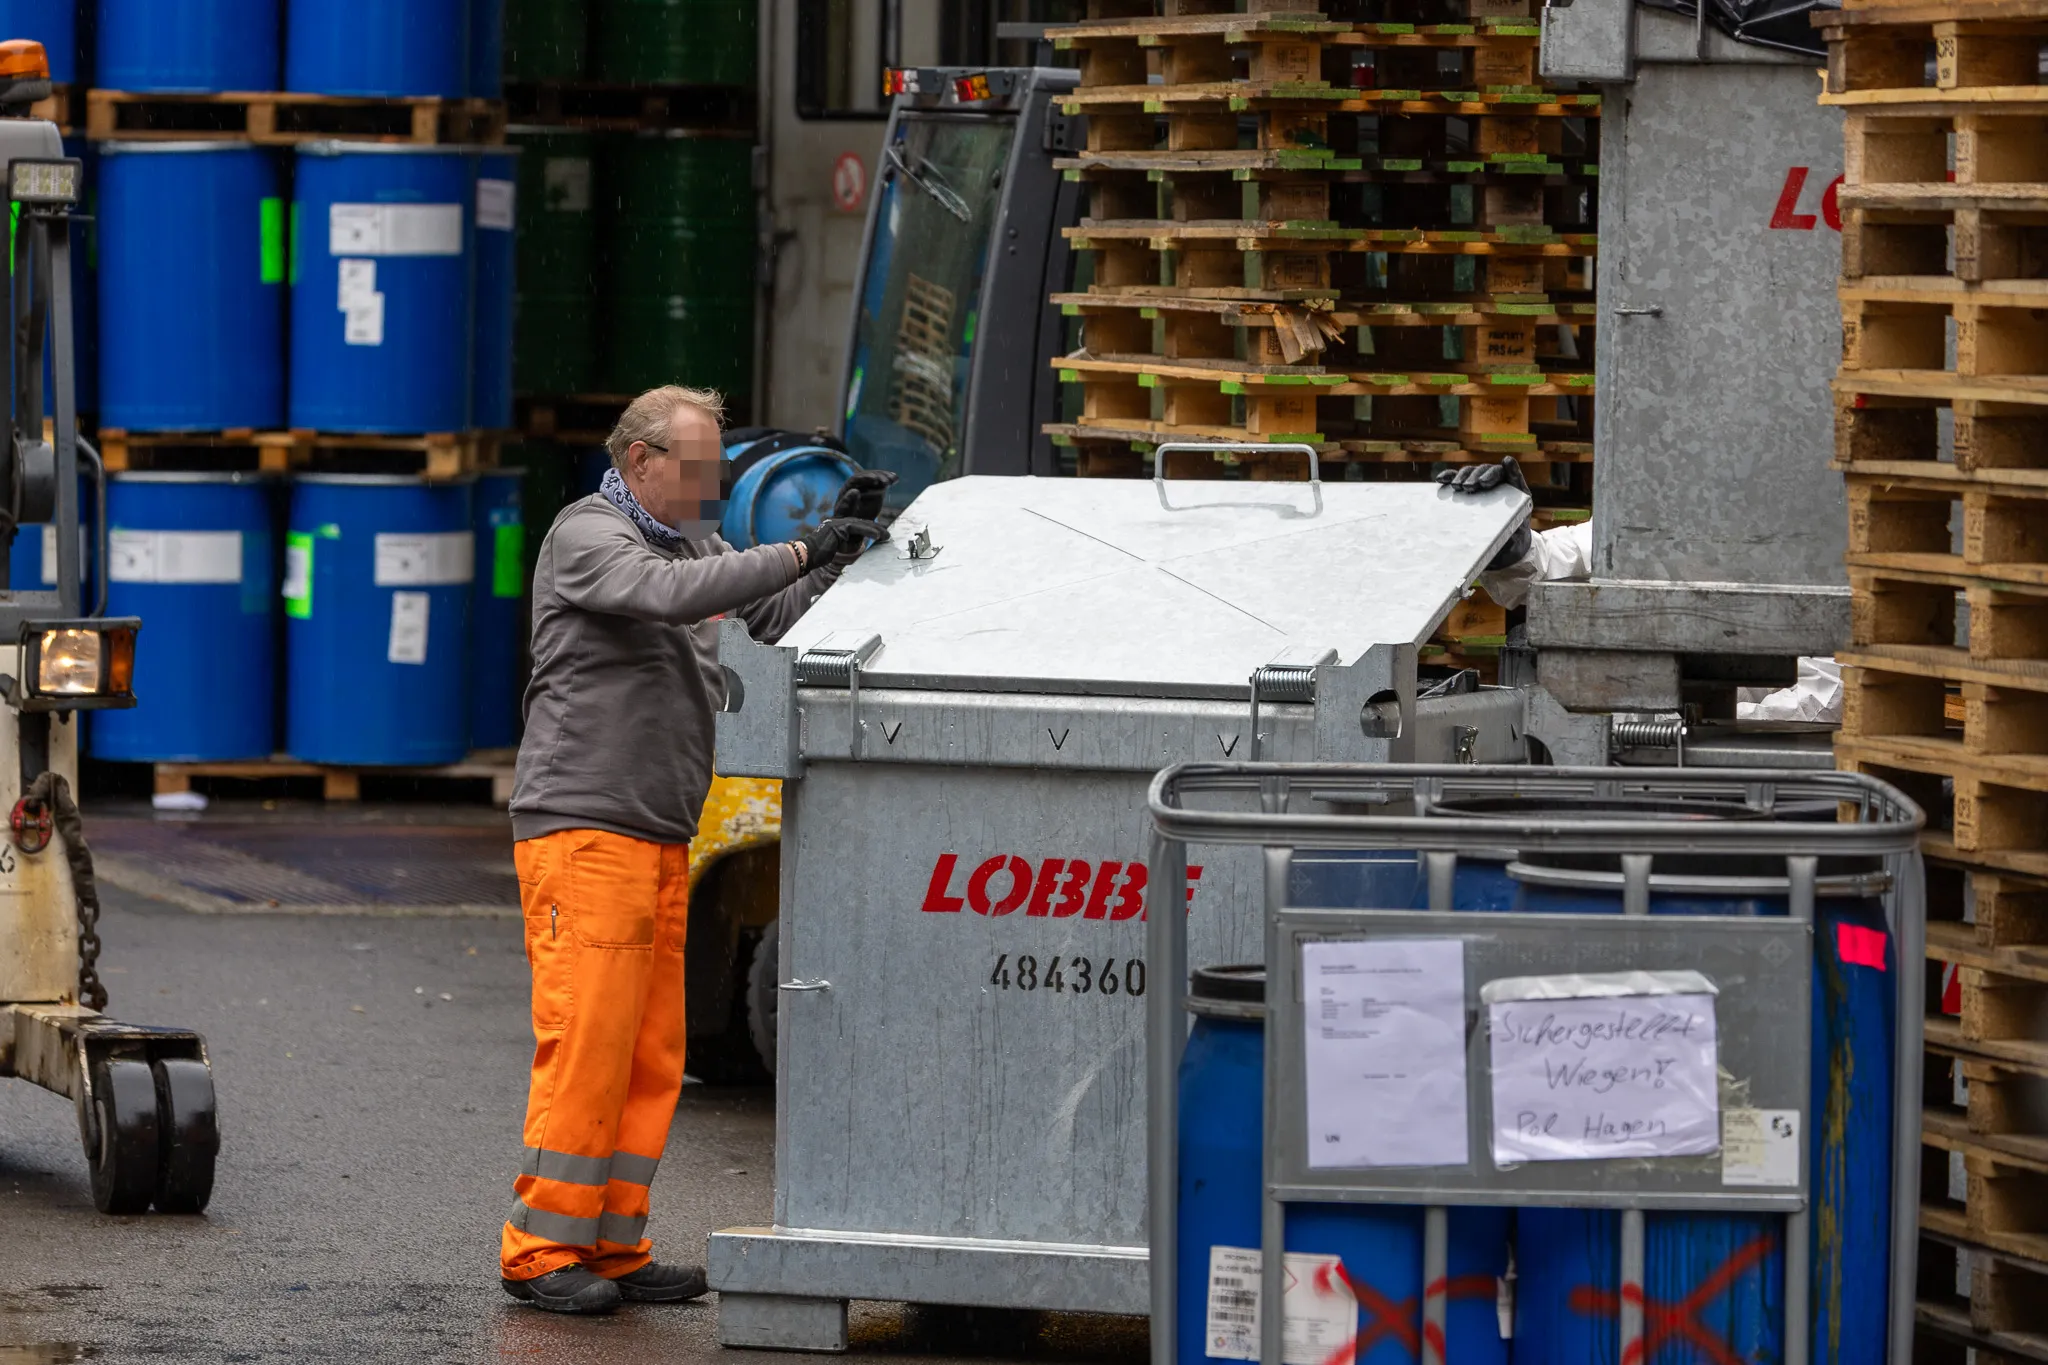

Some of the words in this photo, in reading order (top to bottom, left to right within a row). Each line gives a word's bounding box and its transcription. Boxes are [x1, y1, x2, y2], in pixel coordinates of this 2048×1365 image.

[989, 954, 1146, 996] 484360
[1501, 1010, 1696, 1050] Sichergestellt
[1544, 1056, 1677, 1094] Wiegen!
[1516, 1110, 1559, 1140] Pol
[1583, 1112, 1667, 1143] Hagen
